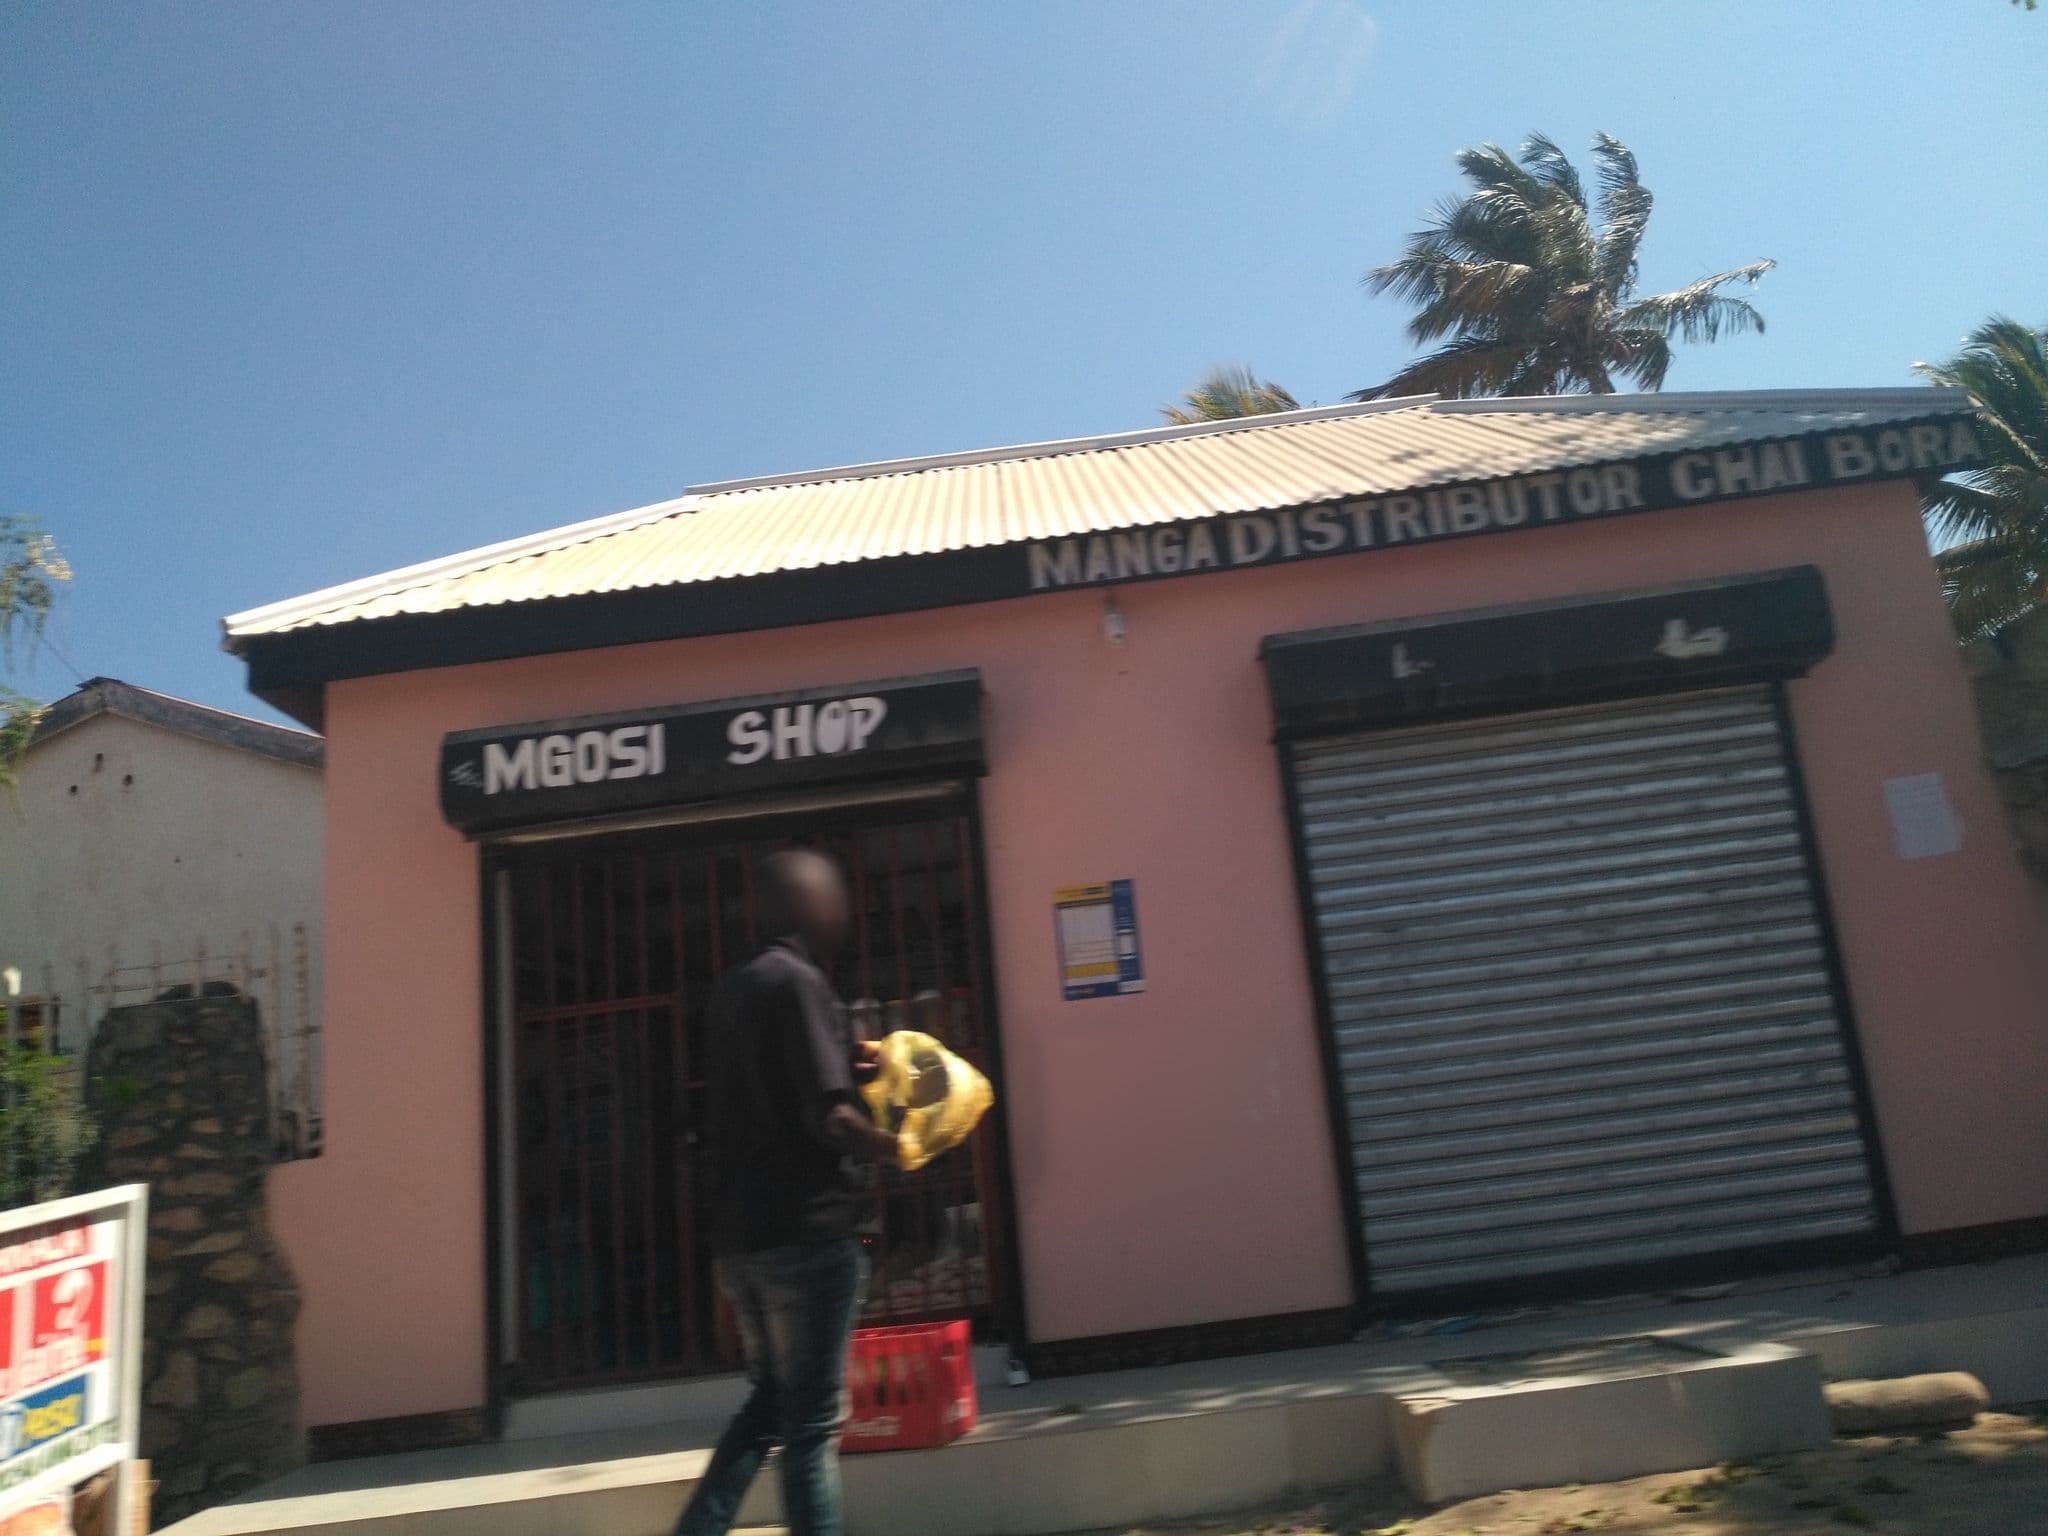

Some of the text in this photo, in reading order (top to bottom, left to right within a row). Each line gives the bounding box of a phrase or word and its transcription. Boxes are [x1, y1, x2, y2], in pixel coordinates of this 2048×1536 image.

[1028, 419, 1982, 589] MANGA DISTRIBUTOR CHAI BORA
[483, 698, 886, 795] MGOSI SHOP
